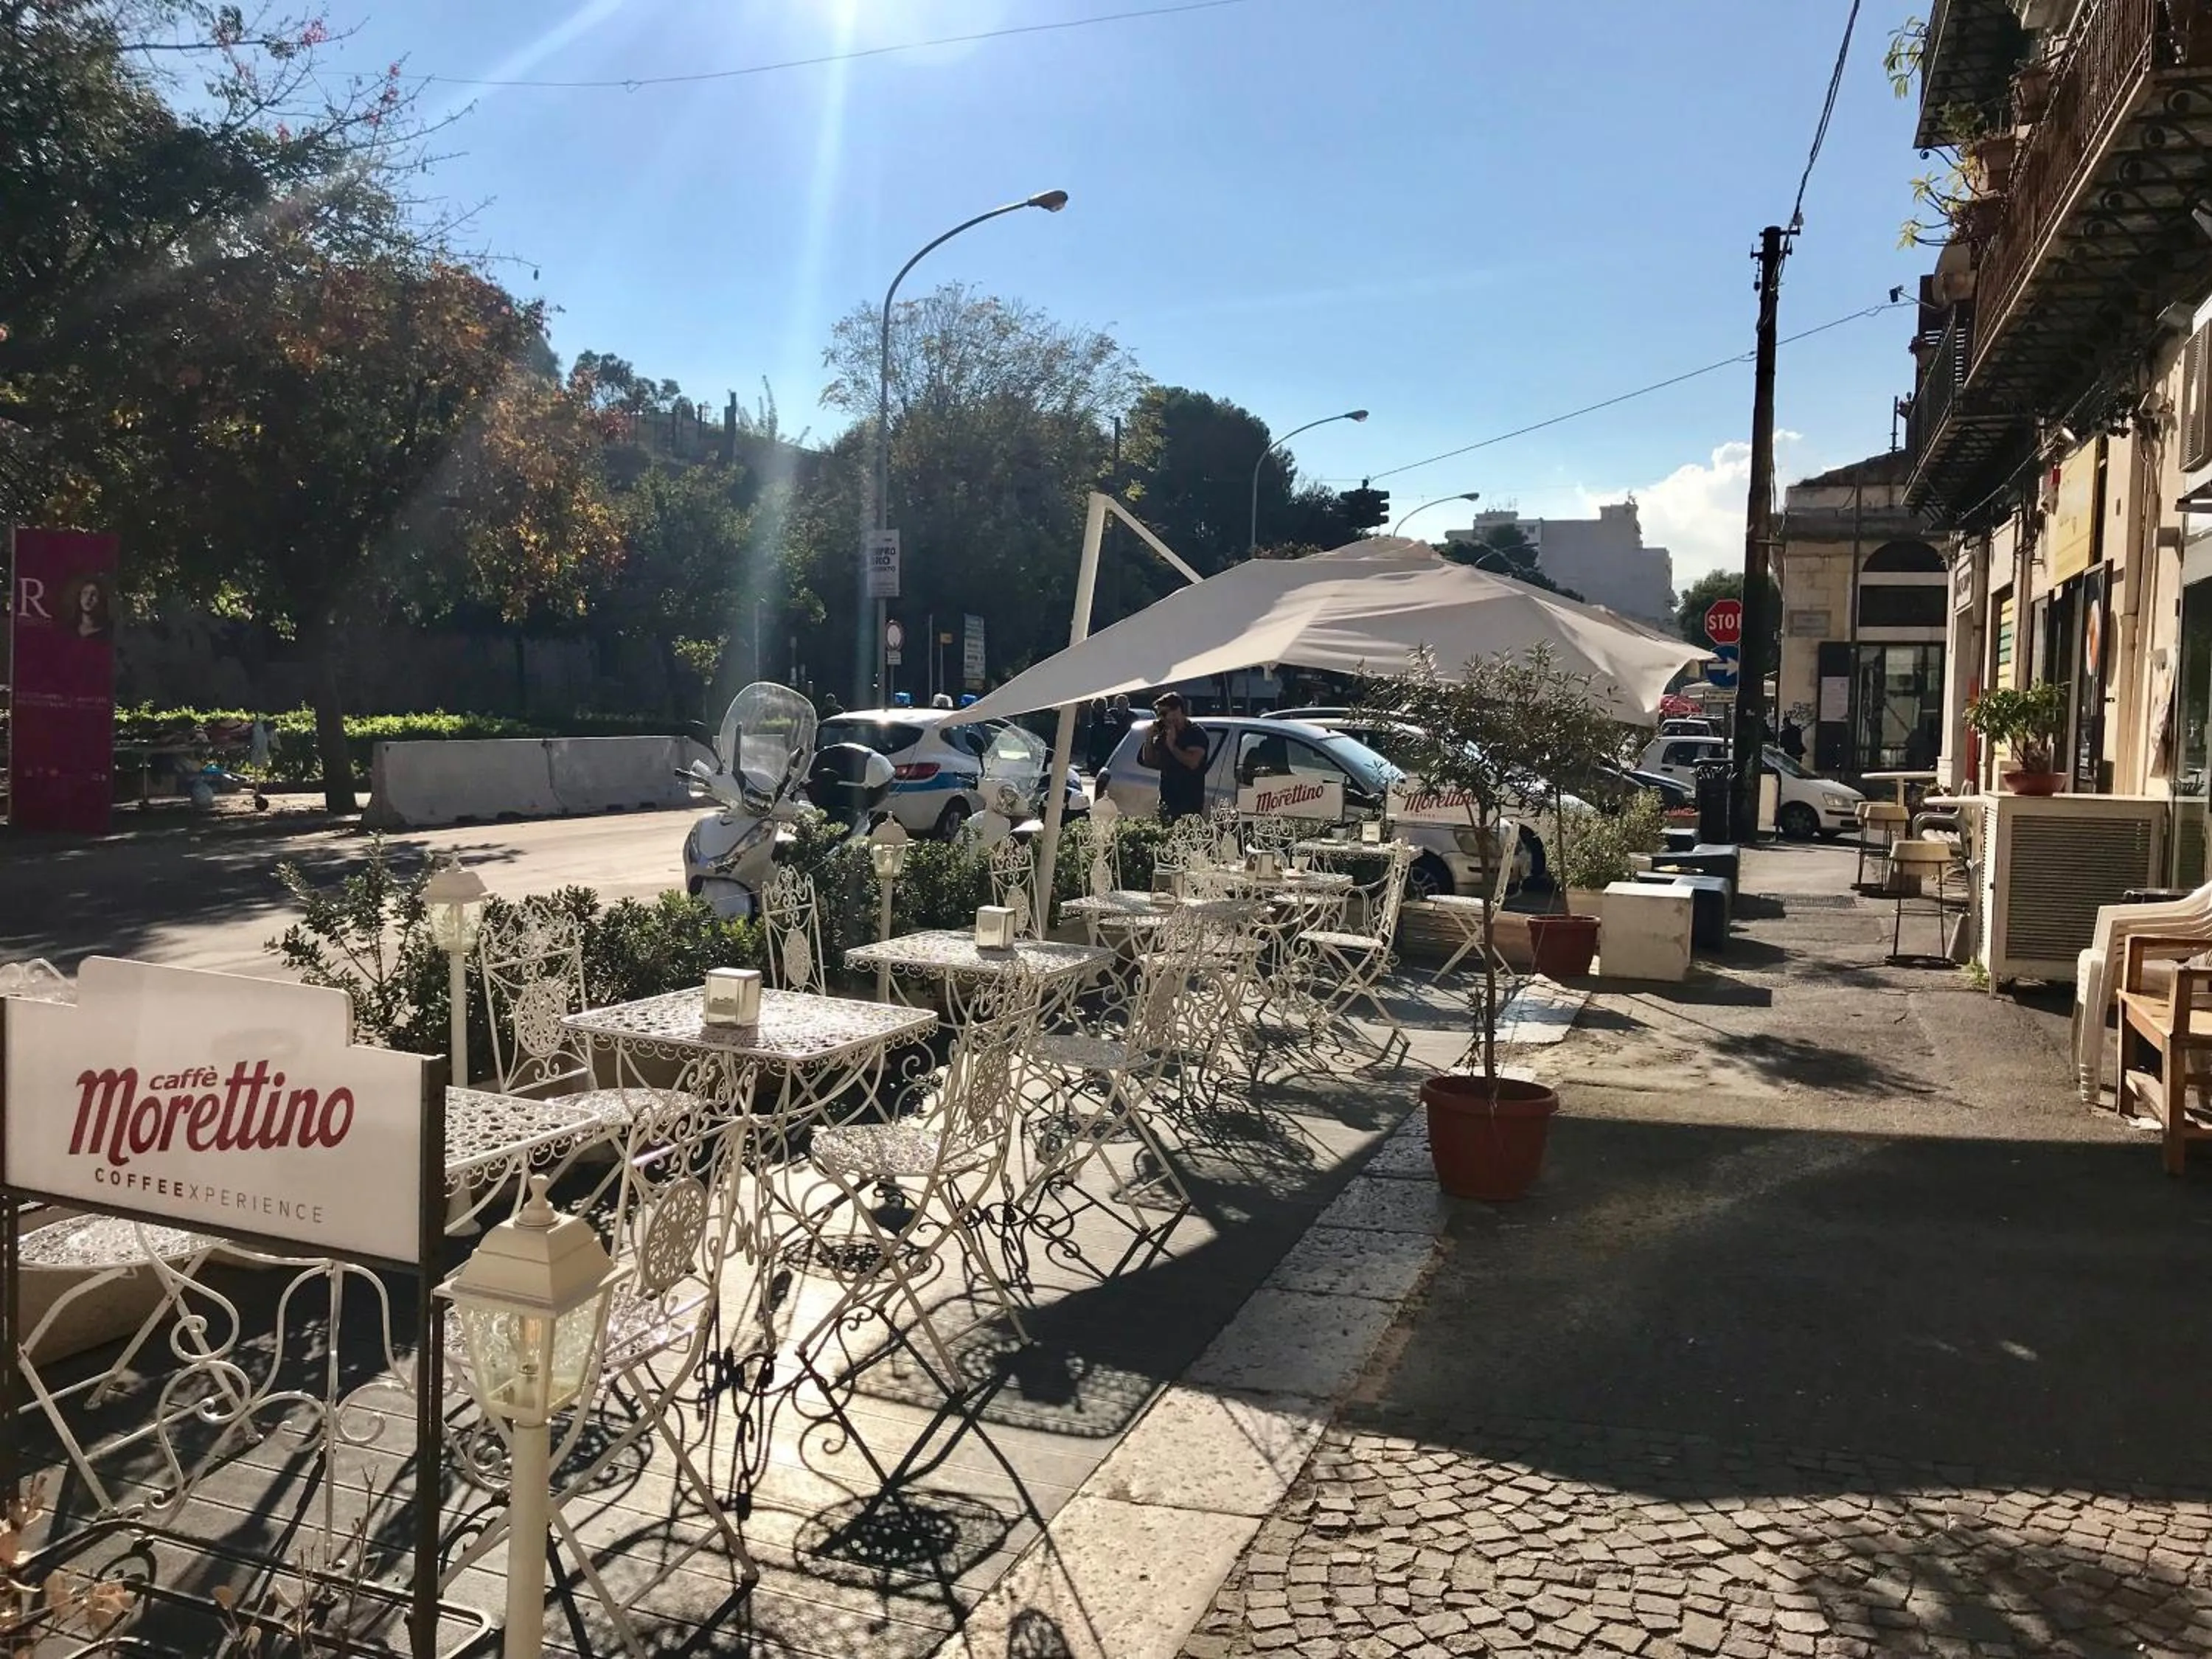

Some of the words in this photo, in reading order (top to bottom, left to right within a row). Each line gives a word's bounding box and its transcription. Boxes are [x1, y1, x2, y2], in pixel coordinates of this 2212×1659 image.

[18, 577, 52, 619] R
[1256, 784, 1324, 812] Morettino
[149, 1065, 218, 1091] caffè
[69, 1060, 355, 1166] Morettino
[94, 1167, 323, 1223] COFFEEXPERIENCE
